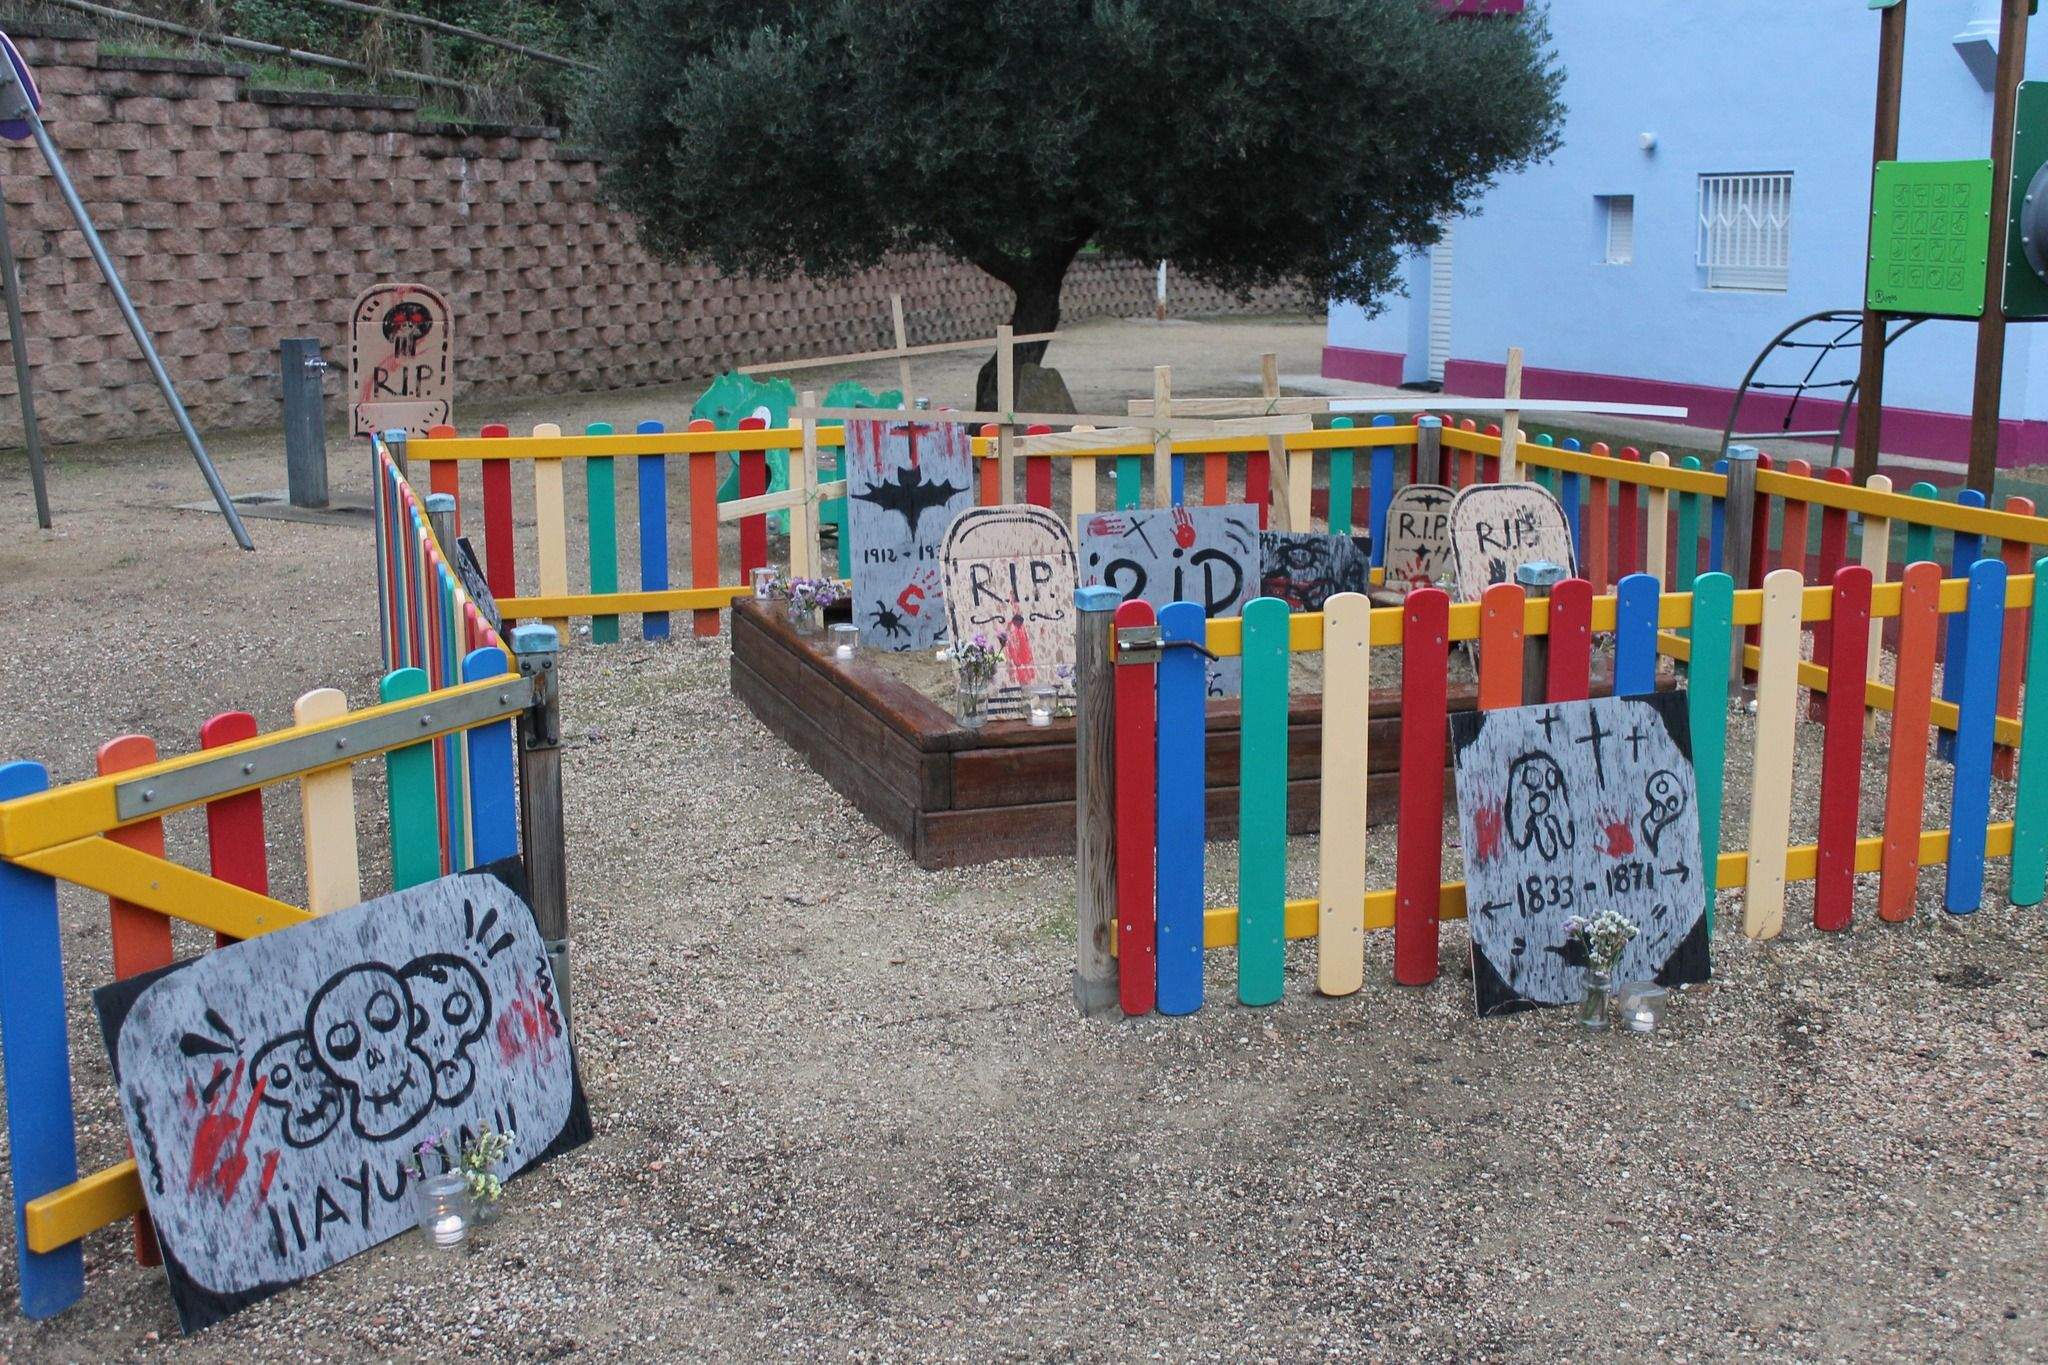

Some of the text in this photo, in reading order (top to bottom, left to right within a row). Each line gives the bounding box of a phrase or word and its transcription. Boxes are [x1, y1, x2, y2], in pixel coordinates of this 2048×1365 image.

[864, 548, 898, 564] 1912
[1516, 874, 1574, 919] 1833
[1606, 859, 1655, 898] 1871
